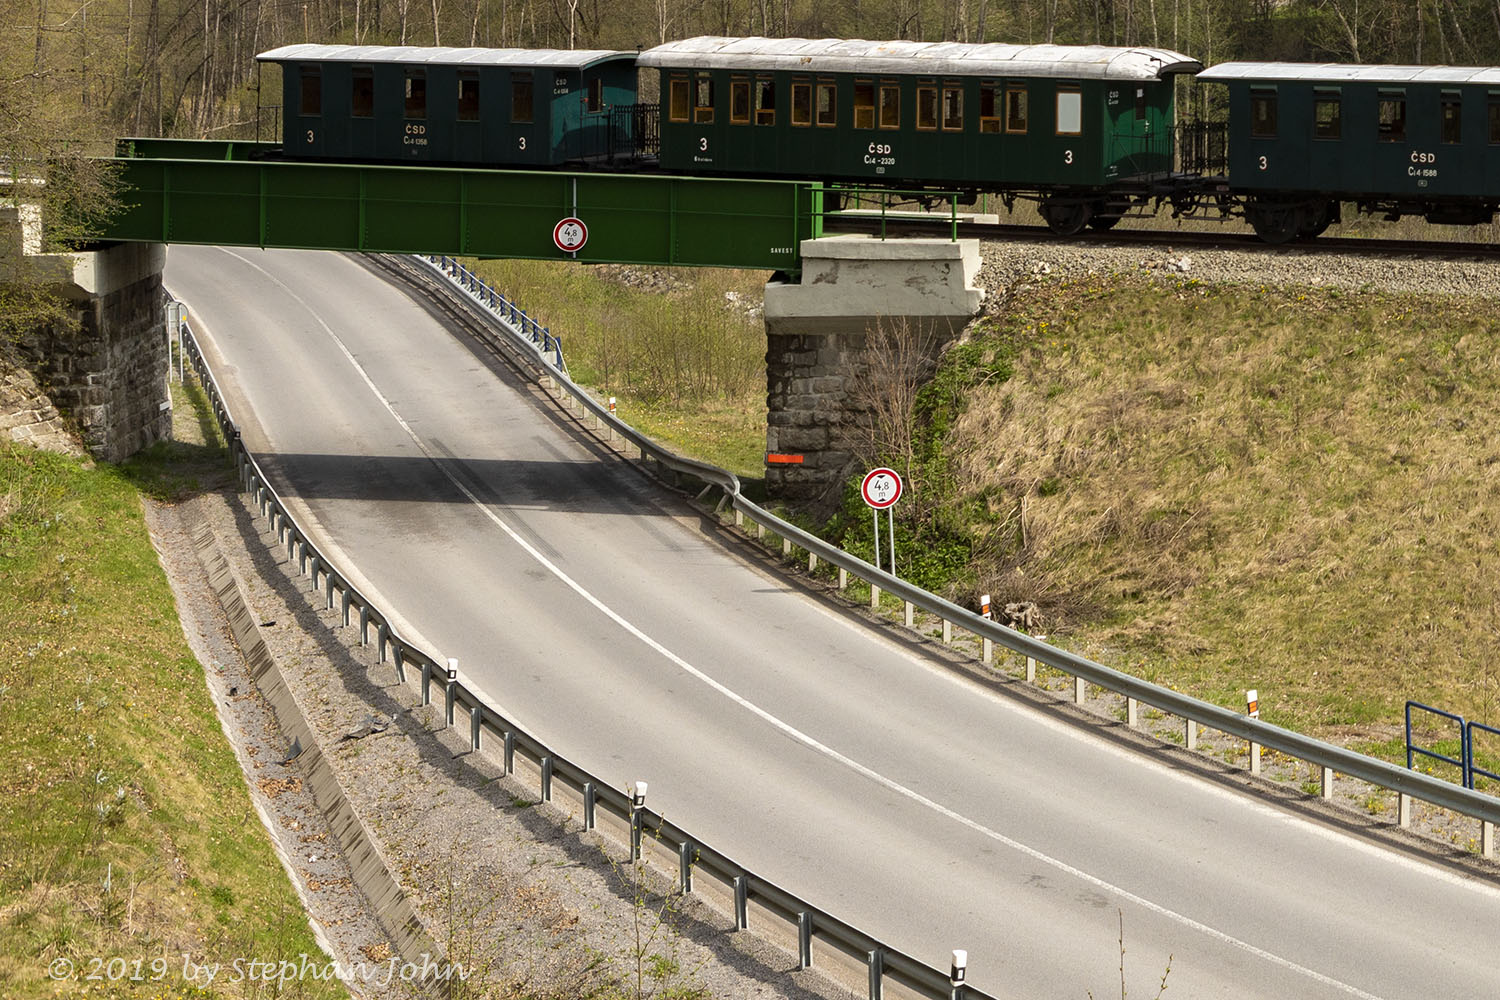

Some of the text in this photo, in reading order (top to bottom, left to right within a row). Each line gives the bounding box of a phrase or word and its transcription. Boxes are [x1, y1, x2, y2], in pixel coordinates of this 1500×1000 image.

[306, 129, 314, 143] 3
[518, 136, 527, 150] 3
[699, 137, 708, 152] 3
[868, 142, 891, 154] ČSD
[1064, 149, 1073, 164] 3
[1258, 155, 1268, 170] 3
[1410, 150, 1435, 163] ČSD
[564, 227, 578, 237] 4,8
[874, 479, 890, 491] 4,8
